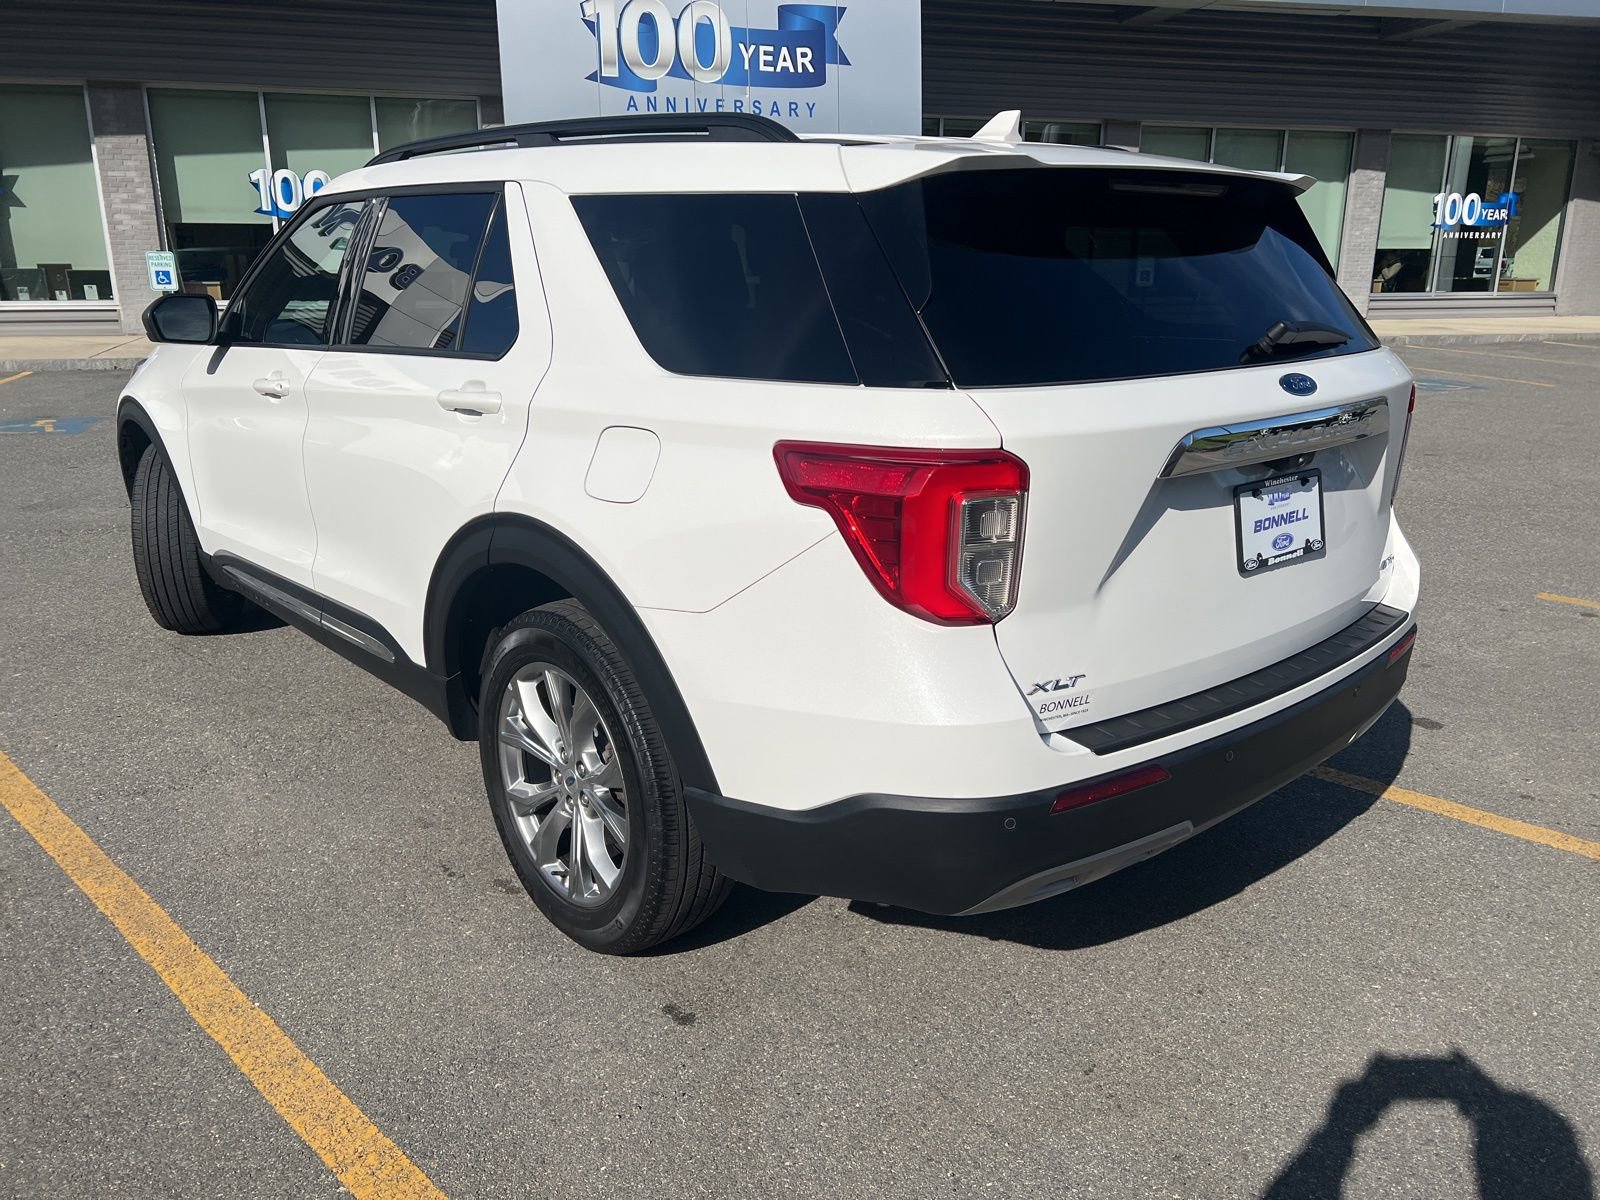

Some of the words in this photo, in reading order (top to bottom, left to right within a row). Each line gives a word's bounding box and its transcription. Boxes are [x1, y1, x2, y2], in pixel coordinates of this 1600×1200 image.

[580, 0, 732, 83] 100
[738, 42, 816, 74] YEAR
[626, 95, 817, 118] ANNIVERSARY
[1433, 193, 1481, 225] 100
[1481, 208, 1508, 220] YEAR
[1442, 231, 1502, 239] ANNIVERSARY
[1264, 475, 1299, 487] Winchester
[1253, 508, 1309, 534] BONNELL
[1026, 674, 1086, 696] XLT
[1040, 695, 1090, 714] BONNELL
